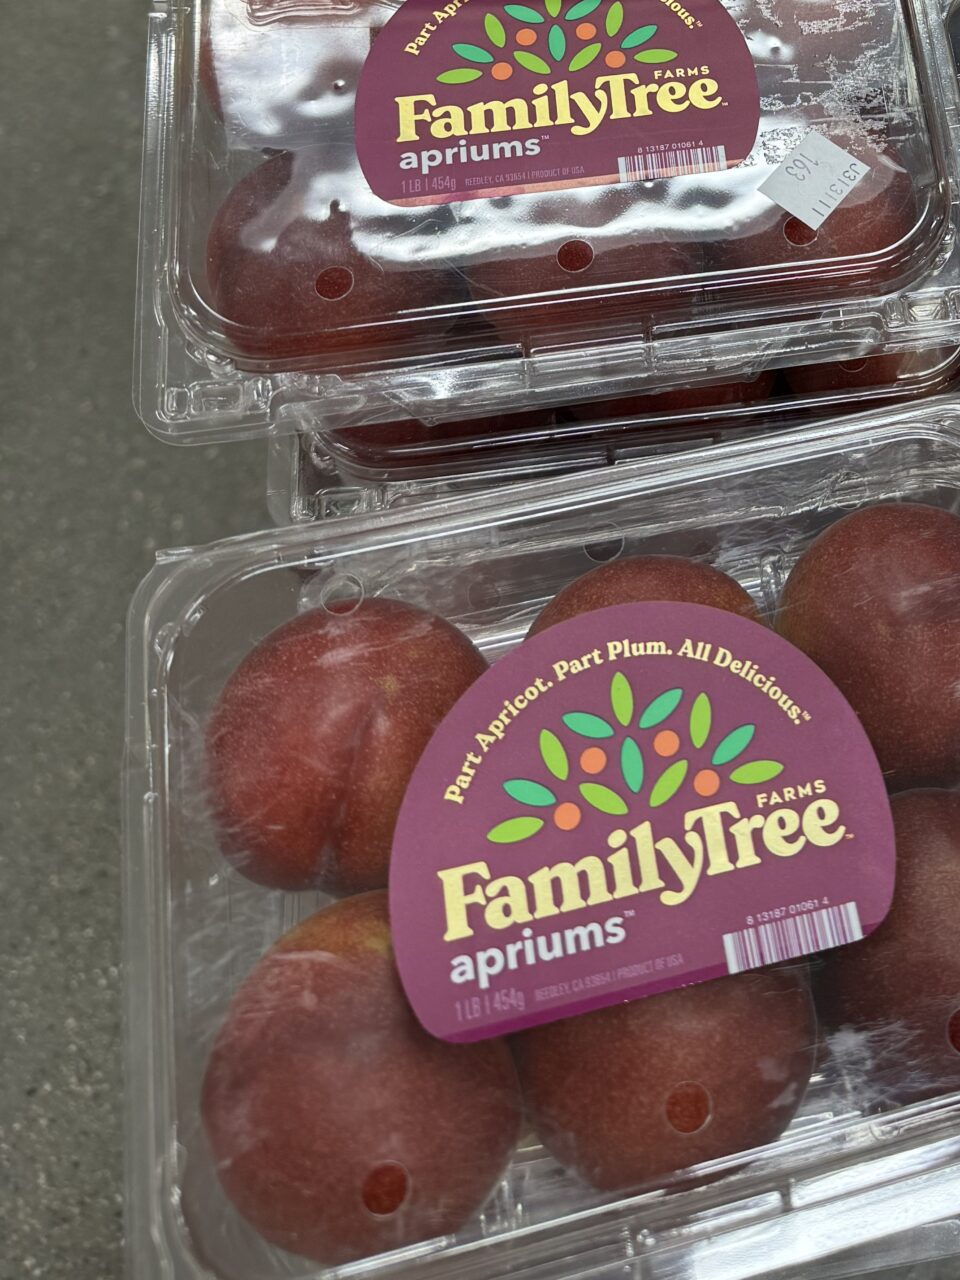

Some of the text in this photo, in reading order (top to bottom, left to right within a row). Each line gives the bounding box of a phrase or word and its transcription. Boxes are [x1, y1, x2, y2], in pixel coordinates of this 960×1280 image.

[403, 24, 437, 56] Part
[654, 65, 709, 79] FARMS
[394, 73, 722, 143] FamilyTree
[399, 138, 541, 174] apriums
[646, 144, 668, 152] 13187
[785, 153, 819, 181] 163
[444, 638, 802, 804] Part Apricot. Part Plum. All Delicious.
[756, 779, 827, 807] FARMS
[437, 799, 845, 942] FamilyTree
[756, 909, 786, 923] 13187
[789, 901, 819, 916] 01061
[449, 915, 626, 989] apriums
